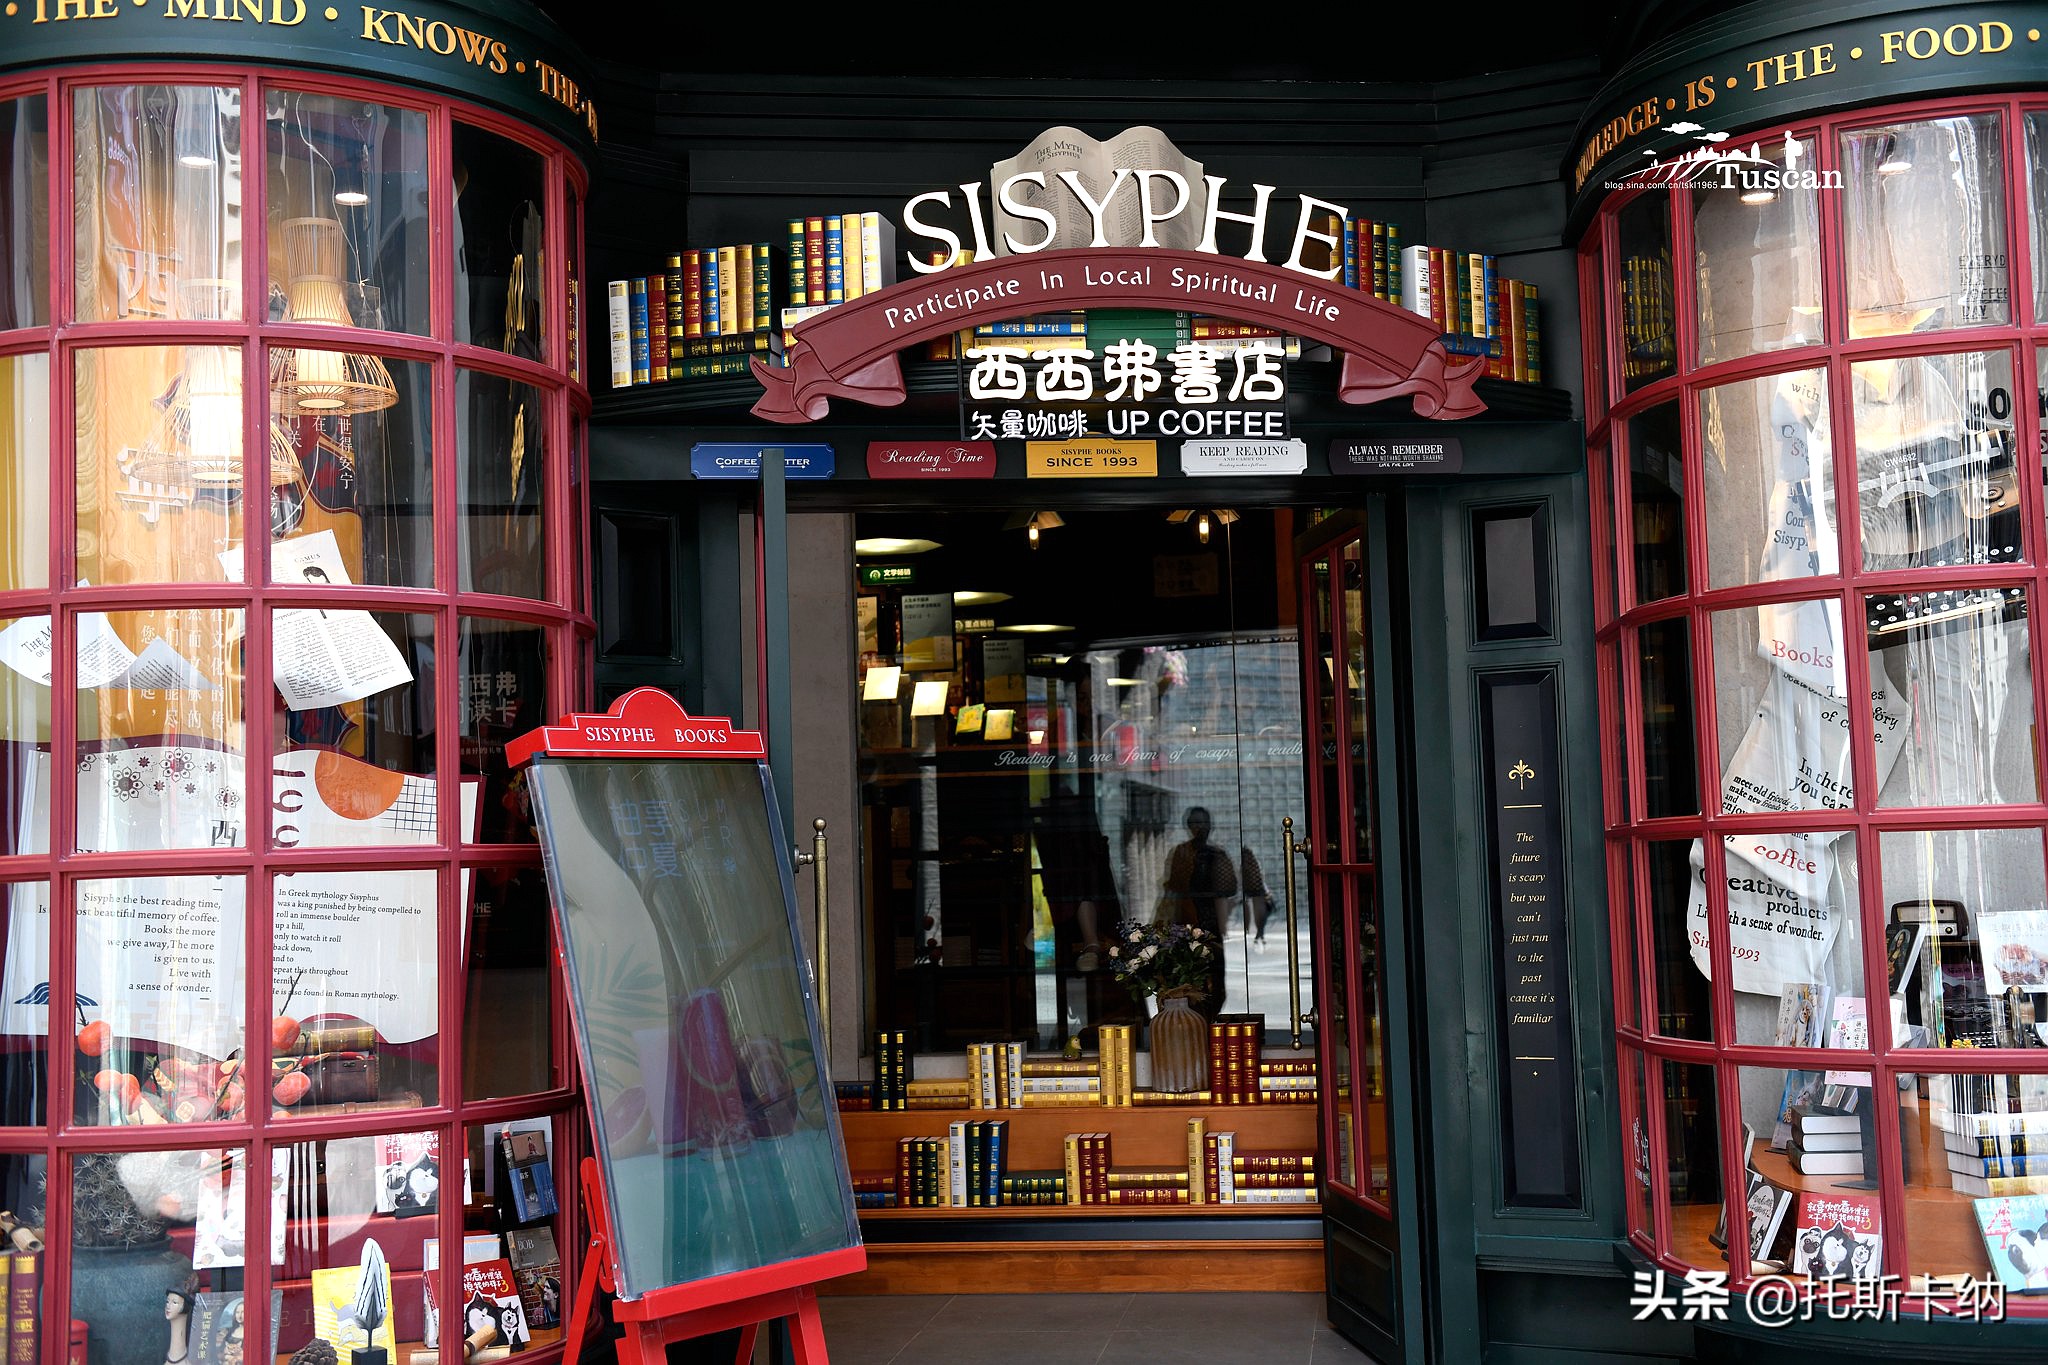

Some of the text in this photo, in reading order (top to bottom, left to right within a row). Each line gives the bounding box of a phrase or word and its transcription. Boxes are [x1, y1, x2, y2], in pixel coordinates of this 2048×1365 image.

[164, 0, 306, 25] MIND
[361, 6, 508, 73] KNOWS
[536, 60, 580, 114] THE
[1685, 75, 1716, 112] IS
[1747, 43, 1837, 91] THE
[1879, 22, 2014, 64] FOOD
[902, 168, 1350, 280] SISYPHE
[885, 266, 1341, 329] Participate In Local Spiritual Life
[966, 337, 1286, 404] 西西弗書店
[971, 409, 1088, 440] 矢量咖啡
[1107, 410, 1285, 437] UP COFFEE
[338, 413, 353, 489] 世得安宁
[880, 447, 984, 466] Reading Time
[1200, 446, 1289, 457] KEEP READING
[1348, 444, 1444, 456] ALWAYS REMEMBER
[715, 457, 757, 465] COFFEE
[1046, 456, 1138, 467] SINCE 1993
[1771, 639, 1833, 669] Books
[1821, 710, 1838, 722] of
[586, 726, 727, 743] SISYPHE BOOKS
[995, 744, 1188, 769] Reading is one form of
[1798, 756, 1812, 777] In
[1728, 785, 1748, 798] make
[1733, 775, 1753, 790] meet
[1753, 785, 1768, 798] old
[1789, 777, 1818, 799] you
[1724, 793, 1739, 804] and
[1516, 831, 1534, 842] The
[1510, 852, 1540, 864] future
[1754, 844, 1817, 874] coffee
[1508, 872, 1546, 885] is scary
[123, 894, 138, 904] the
[141, 896, 159, 905] best
[161, 896, 196, 909] reading
[198, 899, 221, 909] time,
[288, 889, 310, 898] Greek
[311, 891, 348, 901] mythology
[349, 892, 379, 902] Sisyphus
[1510, 892, 1546, 904] but you
[298, 901, 313, 910] king
[314, 902, 346, 912] punished
[347, 903, 357, 913] by
[358, 904, 376, 914] being
[377, 905, 413, 915] compelled
[1766, 900, 1828, 920] products
[76, 908, 92, 917] ost
[94, 908, 136, 919] beautiful
[138, 912, 176, 923] memory
[178, 911, 189, 921] of
[190, 912, 220, 923] coffee.
[300, 912, 331, 920] immense
[332, 914, 360, 922] boulder
[1517, 912, 1541, 923] can't
[144, 925, 216, 937] Books the more
[275, 923, 284, 931] up
[291, 922, 305, 931] hill,
[1741, 917, 1825, 942] a sense of wonder.
[123, 938, 142, 949] give
[191, 943, 215, 951] more
[274, 933, 289, 942] only
[300, 934, 321, 942] watch
[329, 935, 342, 943] roll
[1510, 932, 1548, 944] just run
[290, 944, 313, 953] down,
[1732, 946, 1760, 962] 1993
[154, 954, 215, 965] is given to us.
[1517, 952, 1544, 963] to the
[169, 968, 211, 979] Live with
[273, 966, 348, 976] epeat this throughout
[1520, 973, 1541, 984] past
[136, 983, 161, 991] sense
[163, 982, 173, 992] of
[175, 982, 212, 993] wonder.
[304, 988, 324, 997] found
[334, 990, 359, 998] Roman
[360, 991, 399, 1001] mythology.
[1510, 992, 1555, 1003] cause it's
[1512, 1012, 1553, 1025] familiar
